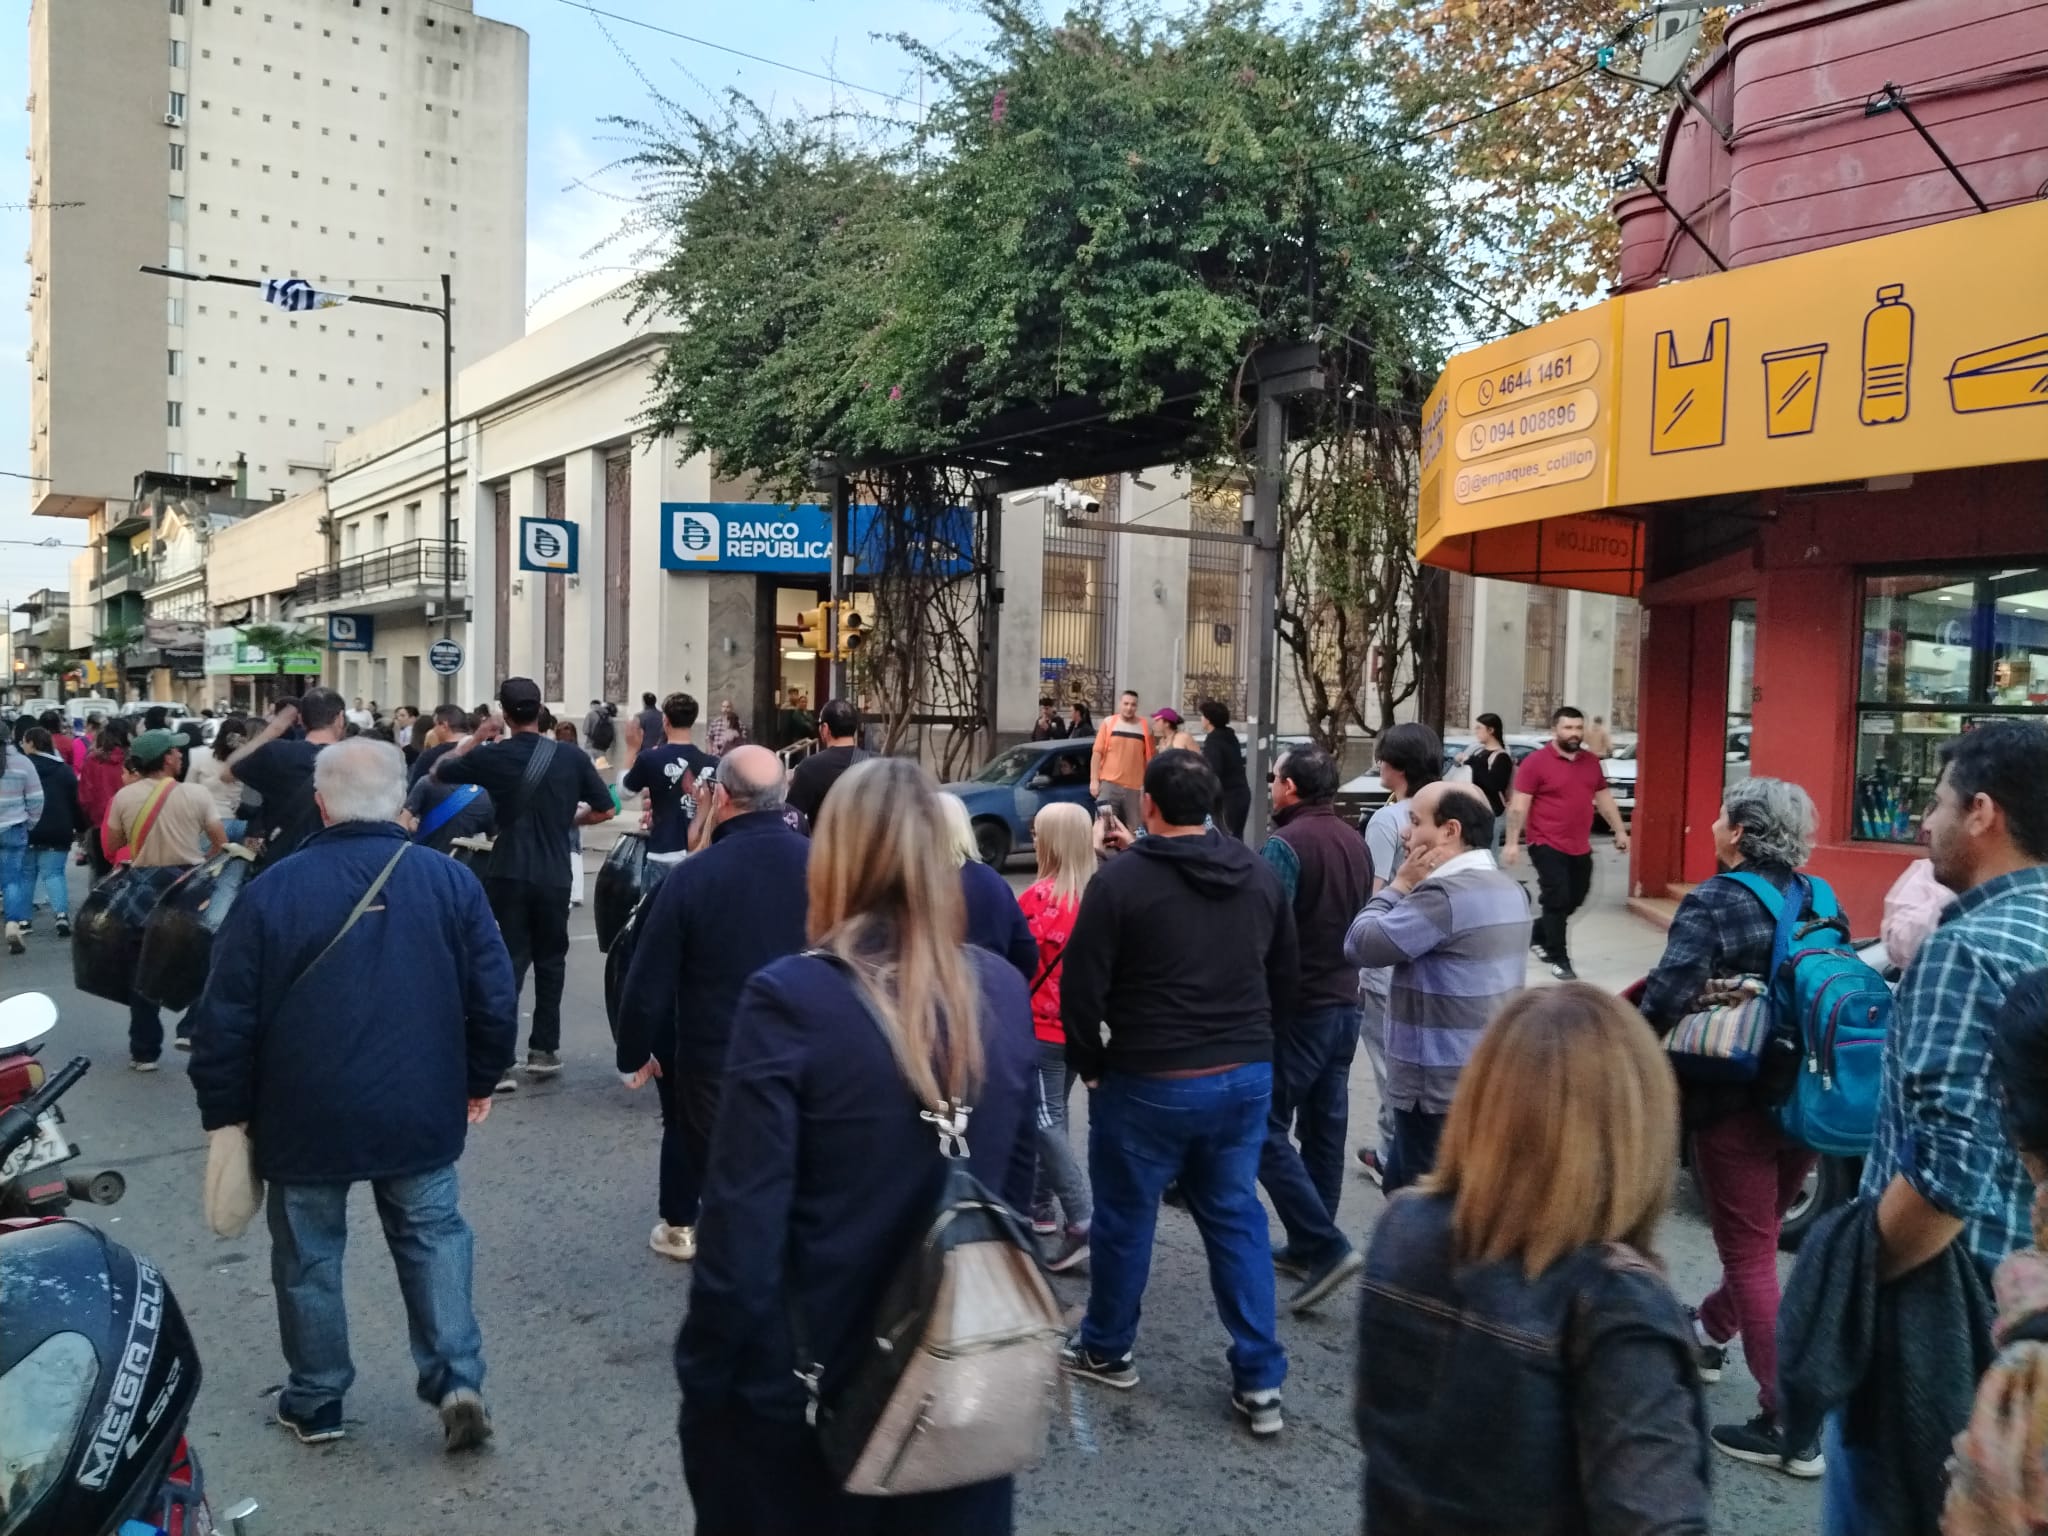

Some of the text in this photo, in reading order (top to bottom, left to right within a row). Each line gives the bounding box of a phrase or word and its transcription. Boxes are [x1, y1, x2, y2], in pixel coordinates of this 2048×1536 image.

[1499, 354, 1573, 395] 4644 1461
[1489, 402, 1576, 443] 094 008896
[1471, 449, 1593, 492] @empaques_cotillon
[727, 521, 799, 539] BANCO
[78, 1341, 150, 1487] MEGA
